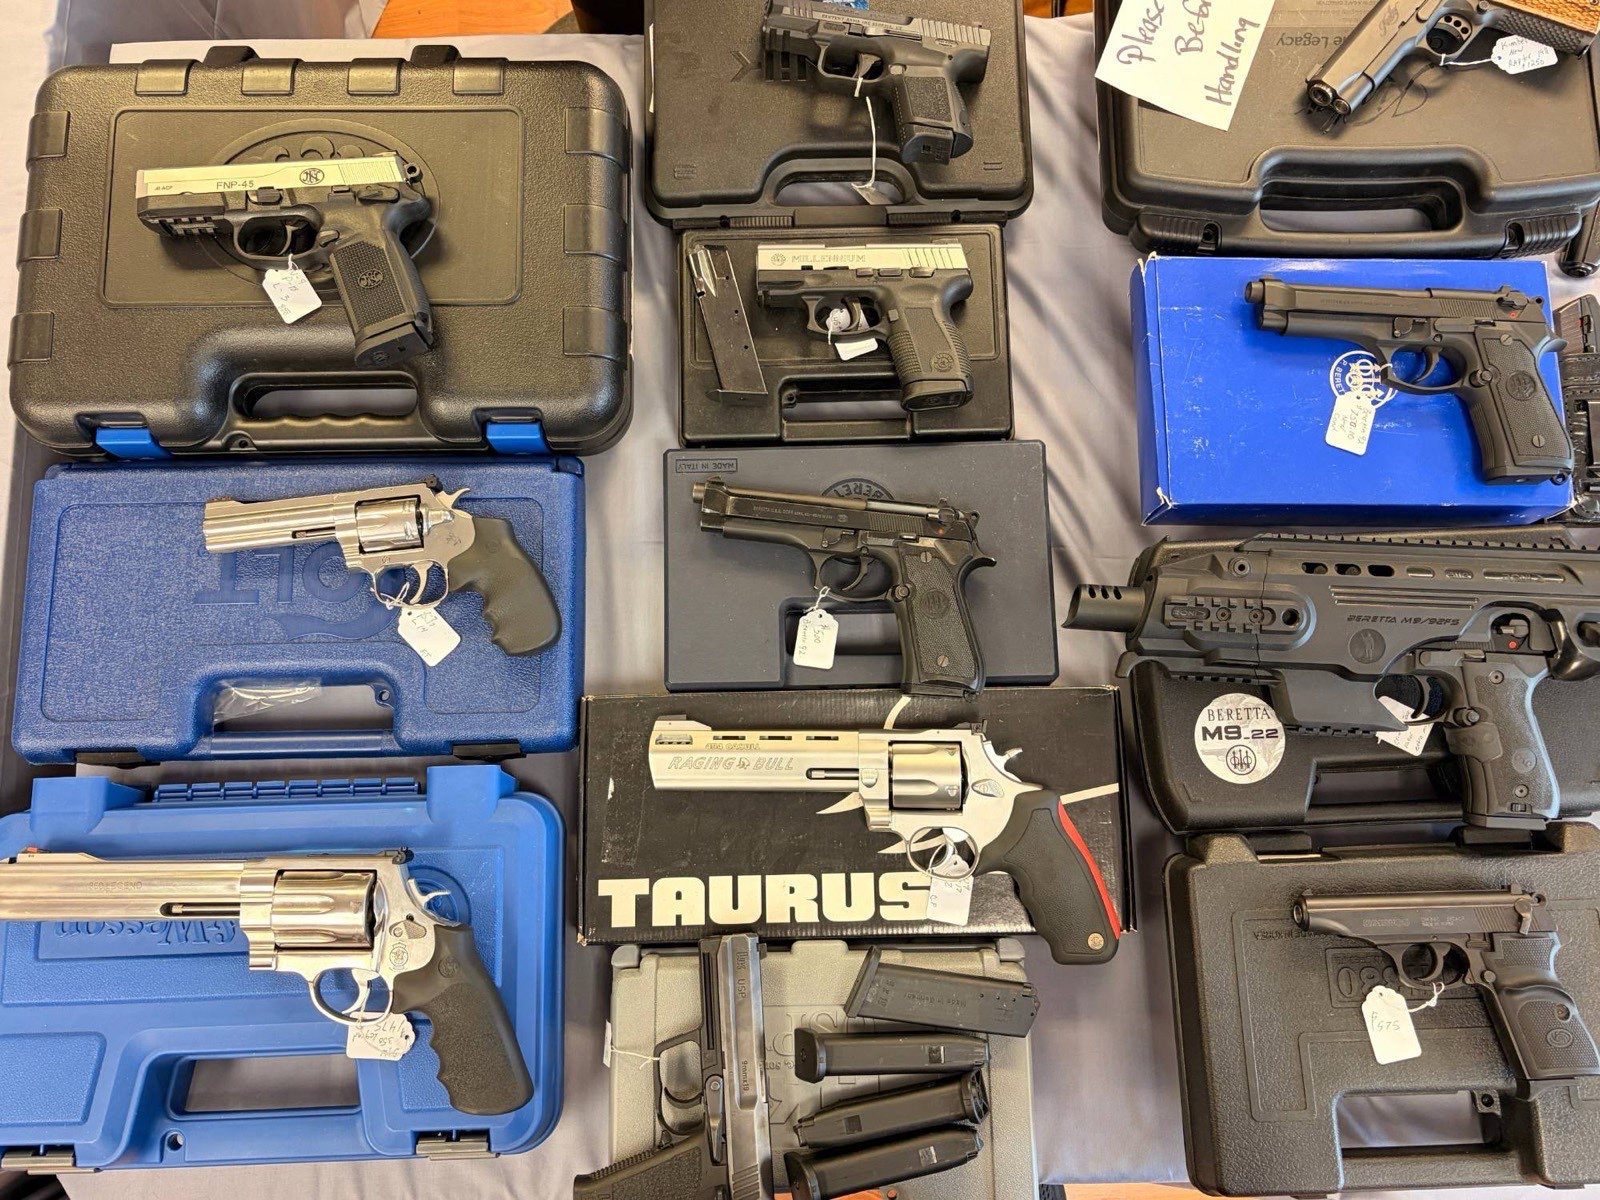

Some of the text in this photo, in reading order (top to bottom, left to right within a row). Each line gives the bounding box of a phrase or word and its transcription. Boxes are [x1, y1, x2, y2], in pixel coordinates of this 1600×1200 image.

[1276, 32, 1328, 48] Legacy
[1203, 17, 1261, 106] Handling
[216, 180, 254, 190] FNP-45
[791, 254, 866, 263] MILLENNIUM
[678, 462, 735, 472] MADE IN ITALY
[1347, 614, 1460, 626] BERETTA M9/92FS
[1207, 707, 1271, 722] BERETTA
[668, 756, 794, 770] RAGING BULL
[598, 871, 932, 928] TAURUS
[736, 978, 747, 999] USP
